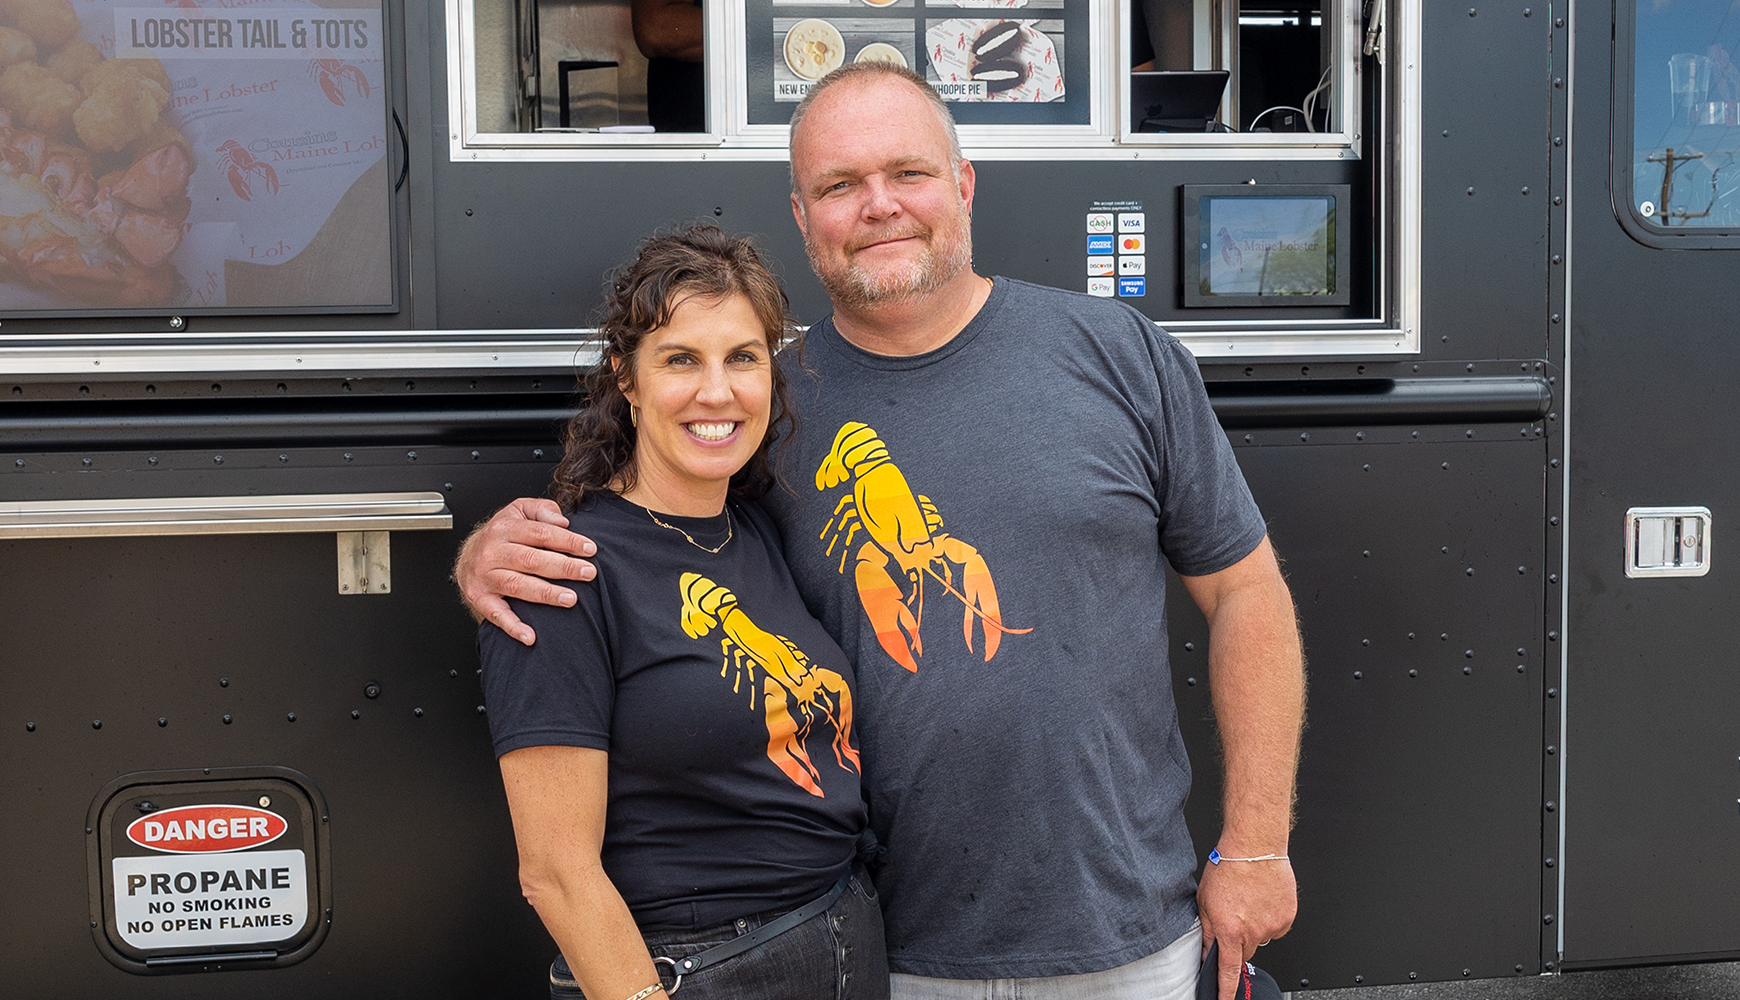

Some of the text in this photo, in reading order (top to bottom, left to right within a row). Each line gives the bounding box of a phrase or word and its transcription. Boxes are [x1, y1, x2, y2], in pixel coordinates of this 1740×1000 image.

[131, 18, 233, 49] LOBSTER
[237, 19, 286, 48] TAIL
[291, 19, 307, 48] &
[311, 19, 368, 48] TOTS
[203, 79, 278, 103] Lobster
[779, 84, 798, 95] NEW
[968, 84, 981, 95] PIE
[247, 130, 338, 153] Cousins
[272, 146, 338, 162] Maine
[1089, 241, 1111, 249] AMEX
[1244, 240, 1319, 251] Maine Lobster
[1129, 261, 1141, 270] Pay
[1099, 283, 1110, 293] Pay
[1126, 286, 1138, 294] Pay
[144, 817, 270, 842] DANGER
[127, 867, 291, 896] PROPANE
[149, 896, 271, 914] NO SMOKING
[127, 913, 293, 934] NO OPEN FLAMES
